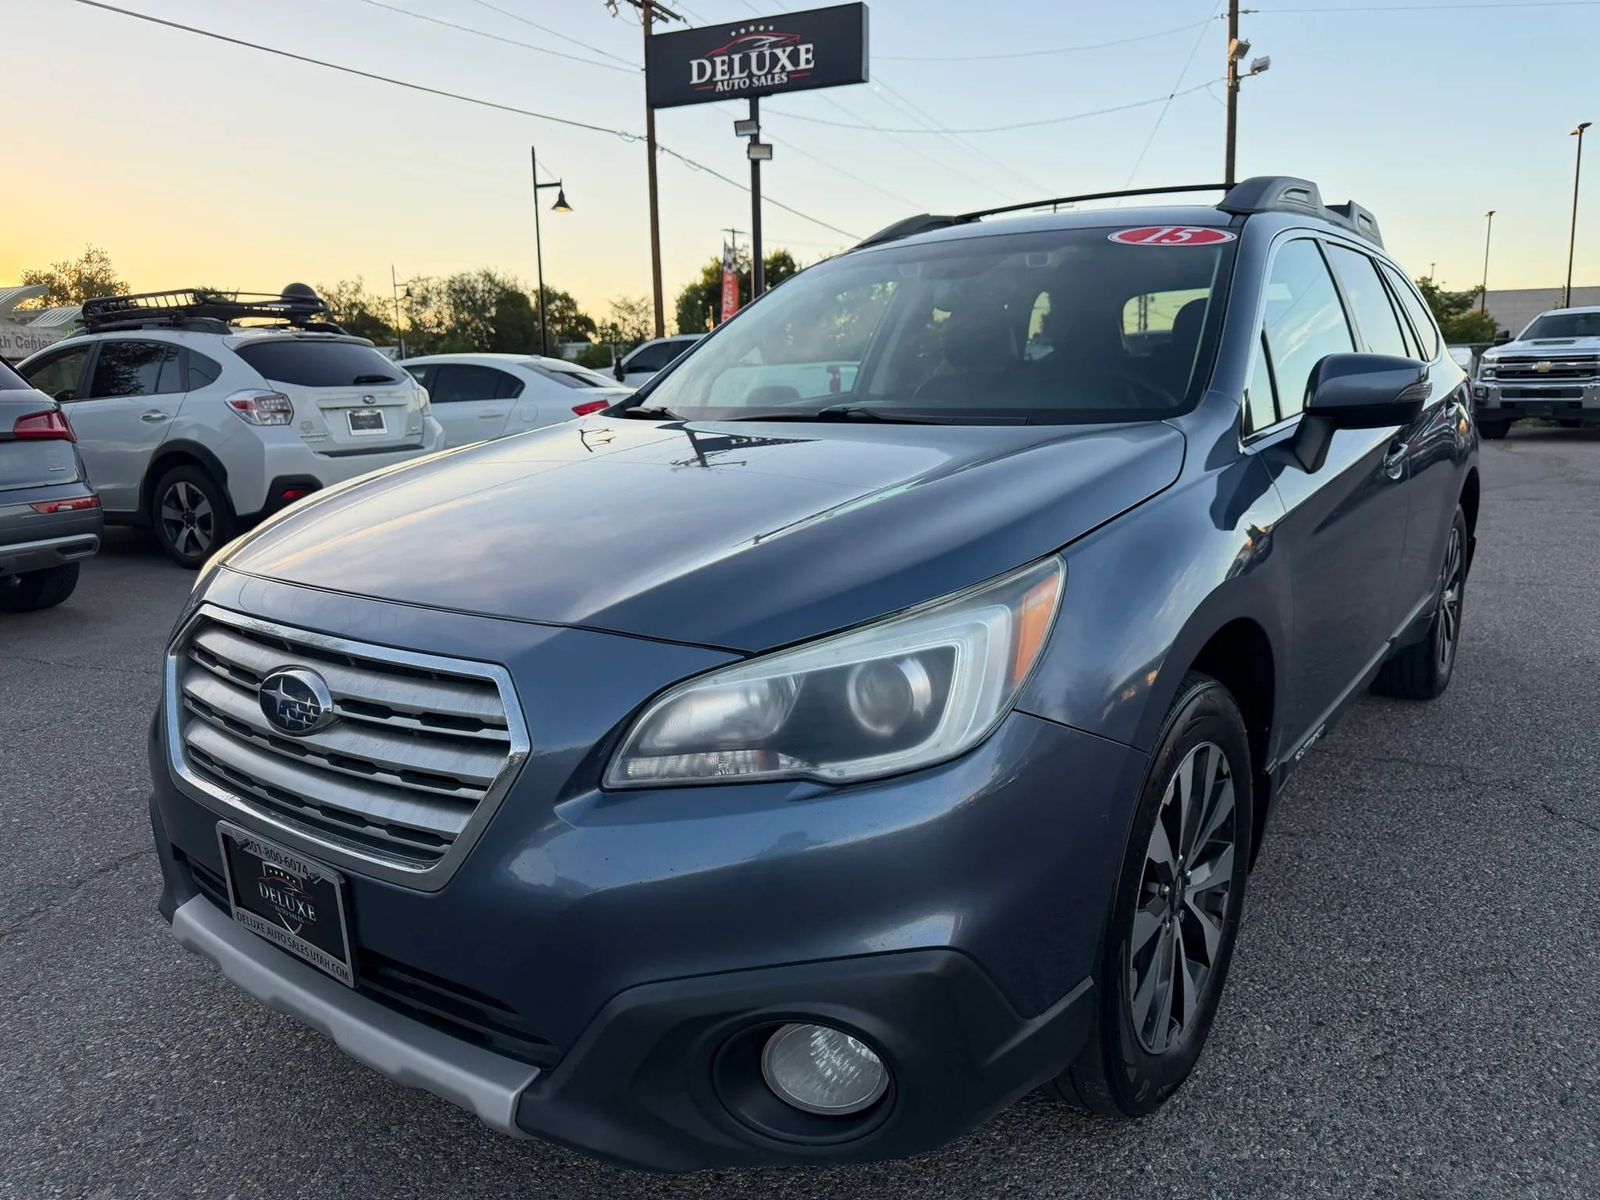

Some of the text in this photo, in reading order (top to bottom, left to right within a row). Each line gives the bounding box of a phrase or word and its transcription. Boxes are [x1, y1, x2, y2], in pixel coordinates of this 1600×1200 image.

[690, 43, 815, 84] DELUXE
[715, 72, 788, 92] AUTO SALES
[1135, 227, 1204, 243] 15
[259, 882, 316, 922] DELUXE
